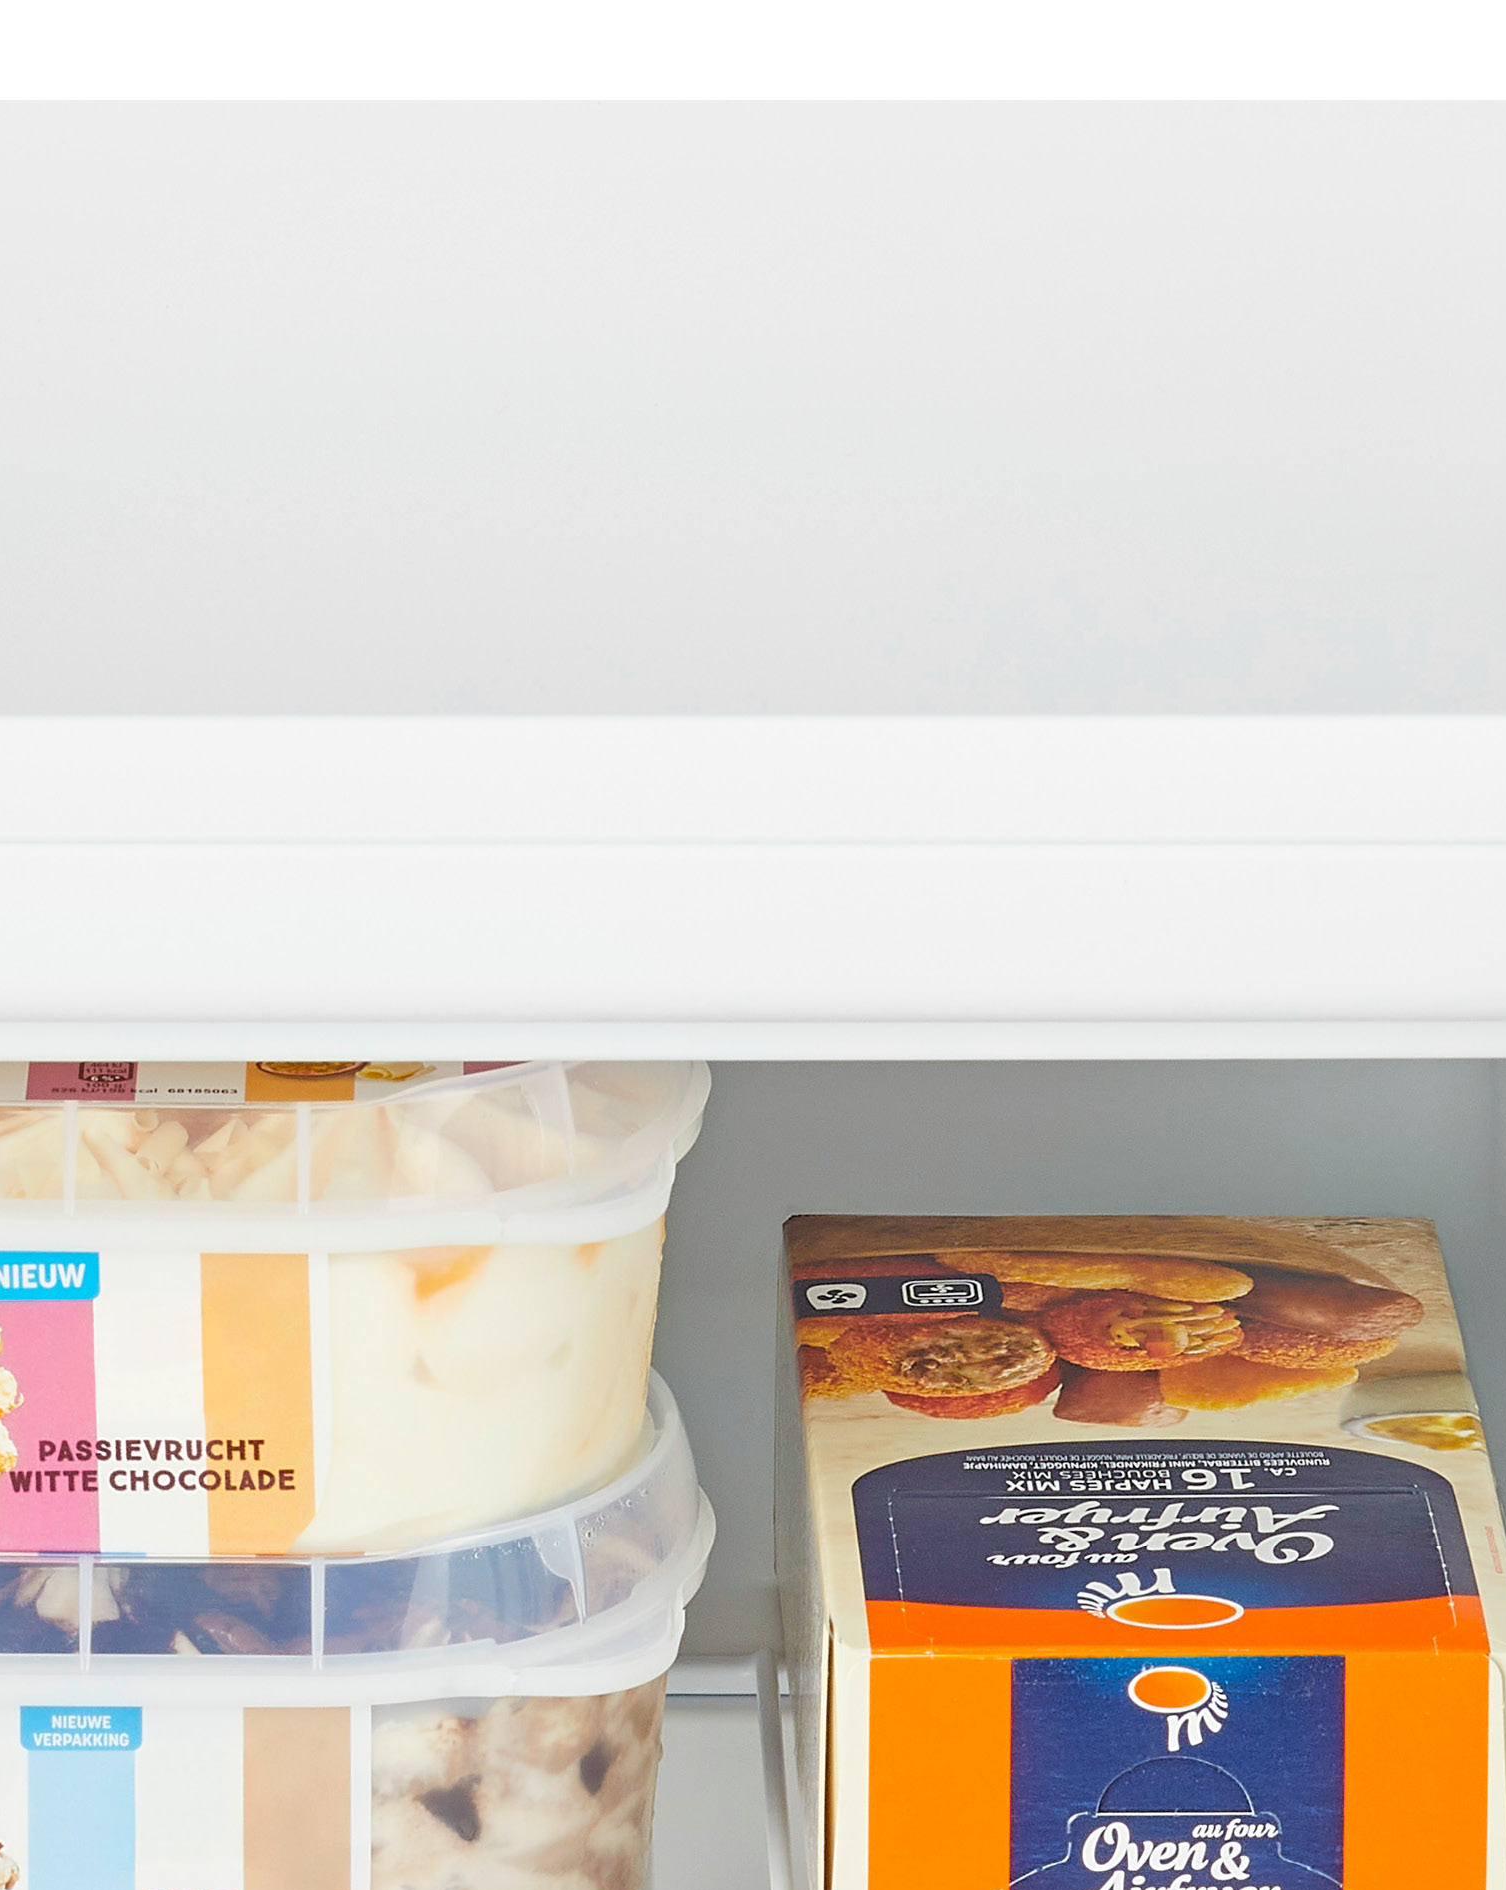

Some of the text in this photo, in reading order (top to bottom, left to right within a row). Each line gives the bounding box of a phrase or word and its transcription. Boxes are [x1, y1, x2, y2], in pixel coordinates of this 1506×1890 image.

[38, 1438, 265, 1462] PASSIEVRUCHT
[962, 1462, 1028, 1470] BAMIHAPJE
[1029, 1462, 1098, 1470] KIPNUGGET,
[1100, 1461, 1167, 1469] FRIKANDEL,
[1197, 1459, 1262, 1467] BITTERBAL,
[1263, 1458, 1331, 1466] RUNDVLEES
[8, 1467, 296, 1493] WITTE CHOCOLADE
[1005, 1467, 1298, 1492] CA. 16 HAPJES MIX
[1012, 1469, 1172, 1481] BOUCHÉES MIX
[980, 1500, 1340, 1534] Airfryer
[1037, 1526, 1335, 1565] Oven &
[987, 1551, 1138, 1568] au four
[51, 1714, 112, 1730] NIEUWE
[32, 1731, 130, 1748] VERPAKKING
[1192, 1817, 1279, 1841] au four
[1082, 1821, 1251, 1882] Oven &
